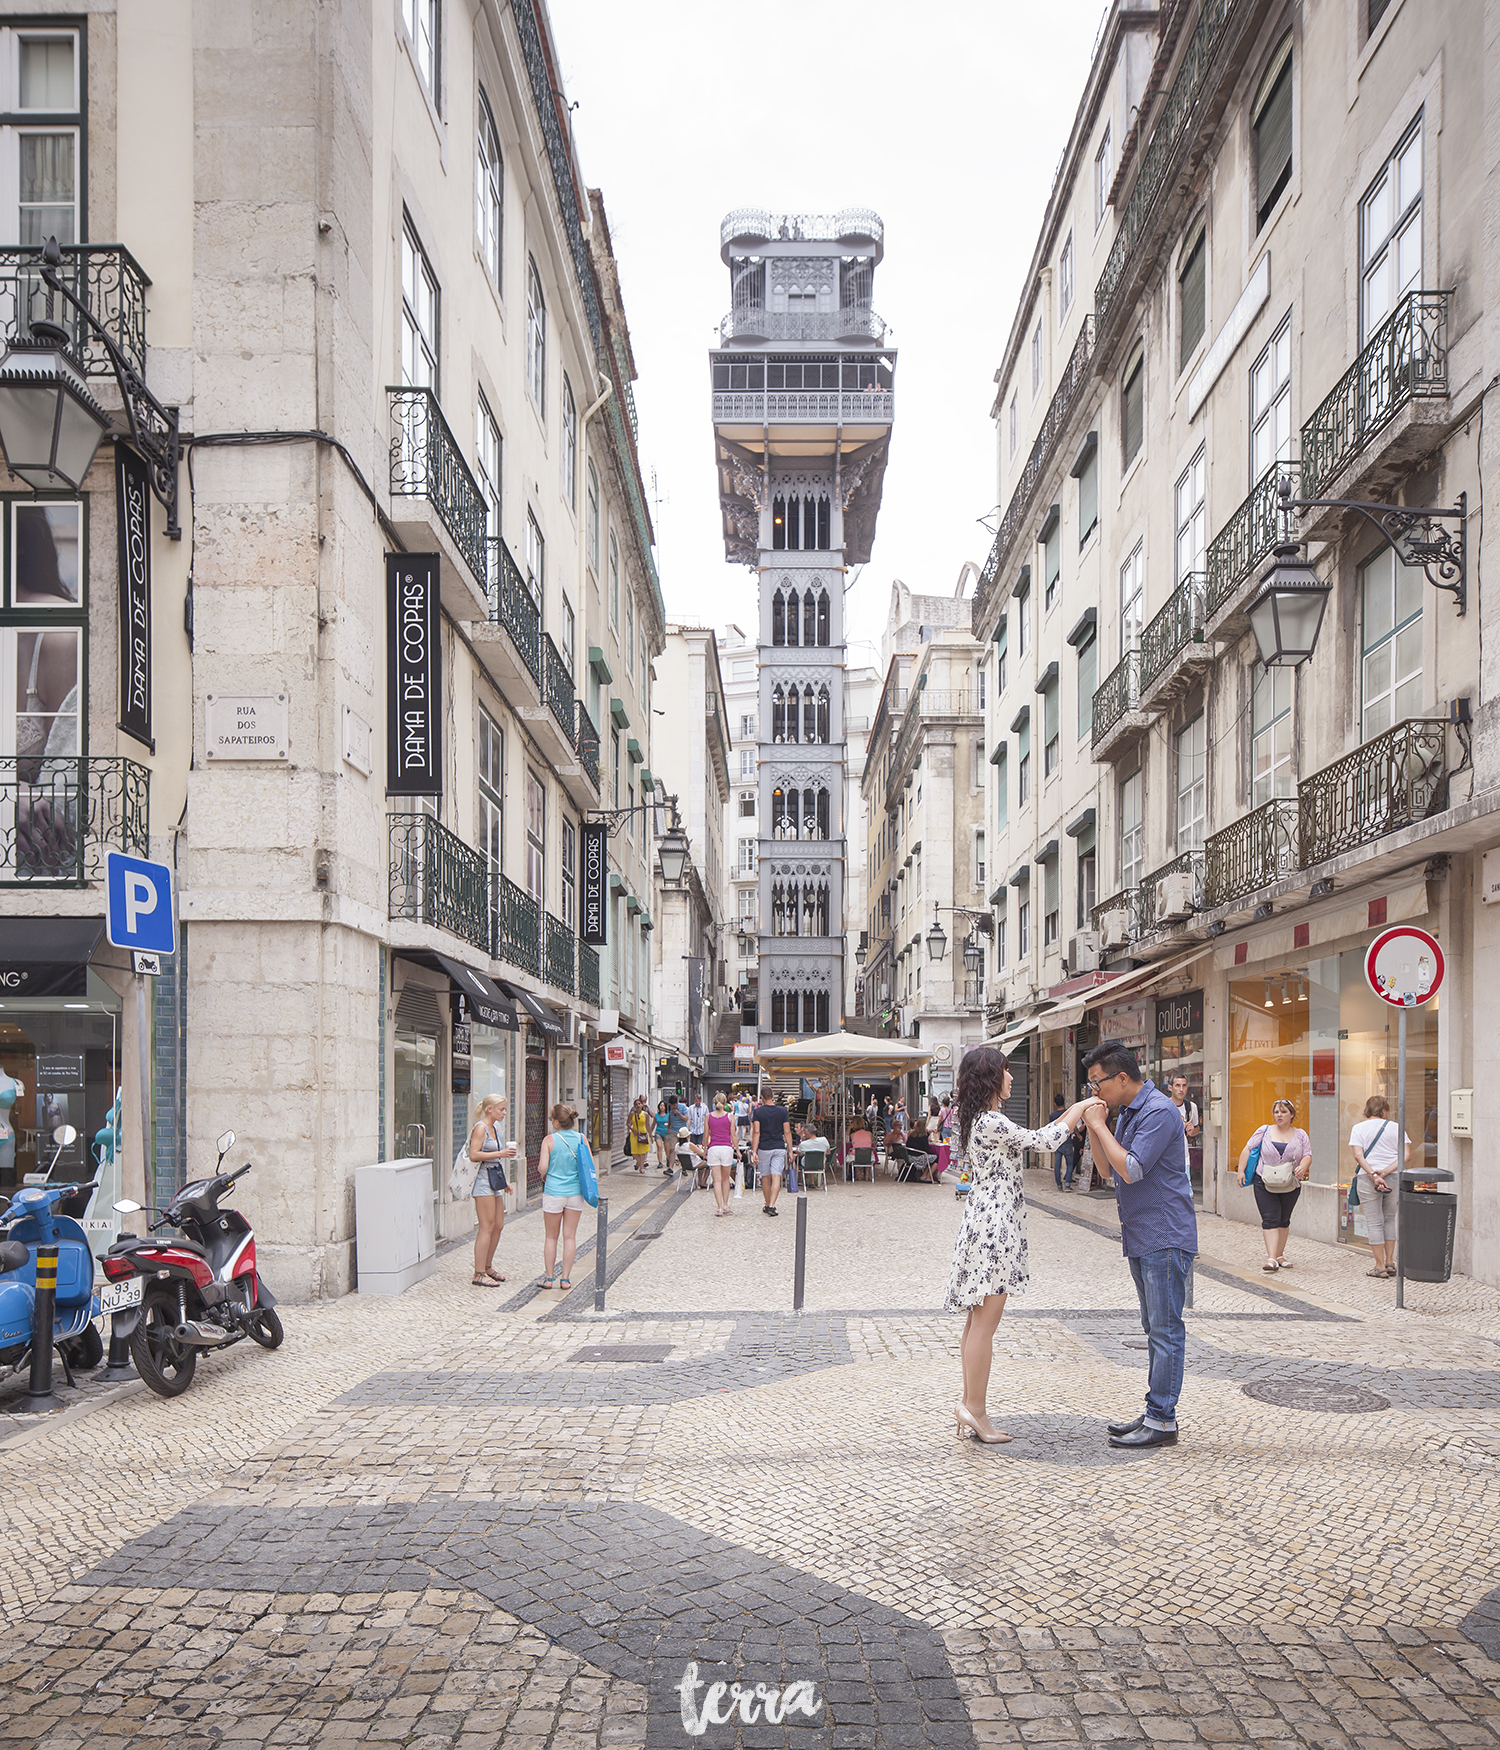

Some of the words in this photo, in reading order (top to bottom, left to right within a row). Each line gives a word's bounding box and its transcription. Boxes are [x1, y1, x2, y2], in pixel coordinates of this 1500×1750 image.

[133, 591, 145, 629] DE
[133, 640, 145, 710] DAMA
[404, 672, 425, 701] DE
[236, 707, 256, 715] RUA
[237, 721, 256, 729] DOS
[218, 735, 275, 744] SAPATEIROS
[404, 711, 426, 769] DAMA
[124, 870, 158, 934] P
[588, 883, 599, 898] DE
[588, 902, 599, 933] DAMA
[1158, 1000, 1192, 1033] collect
[115, 1281, 130, 1295] 93
